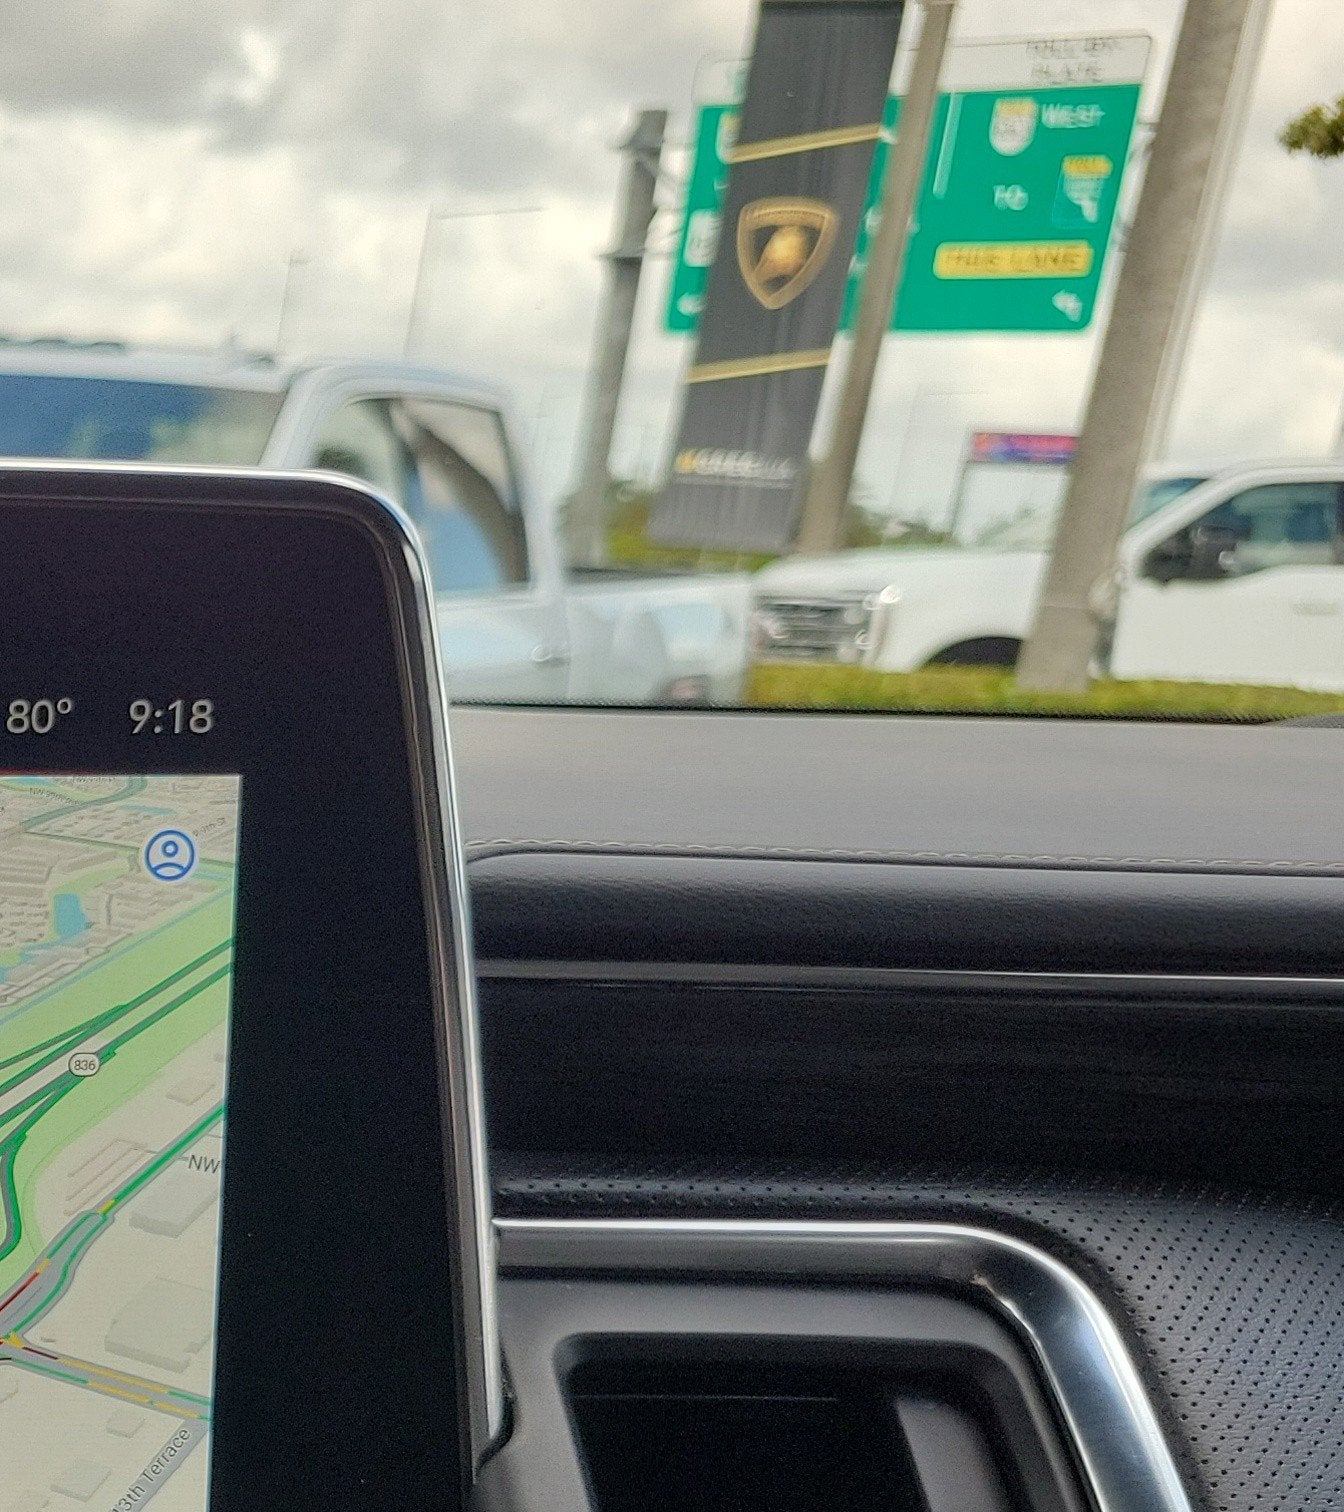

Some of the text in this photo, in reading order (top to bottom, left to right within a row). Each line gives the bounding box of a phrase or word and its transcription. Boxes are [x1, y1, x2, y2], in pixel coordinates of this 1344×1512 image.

[128, 699, 214, 735] 9:18
[73, 1059, 96, 1071] 836
[187, 1154, 221, 1174] NW
[141, 1429, 191, 1483] Terrace
